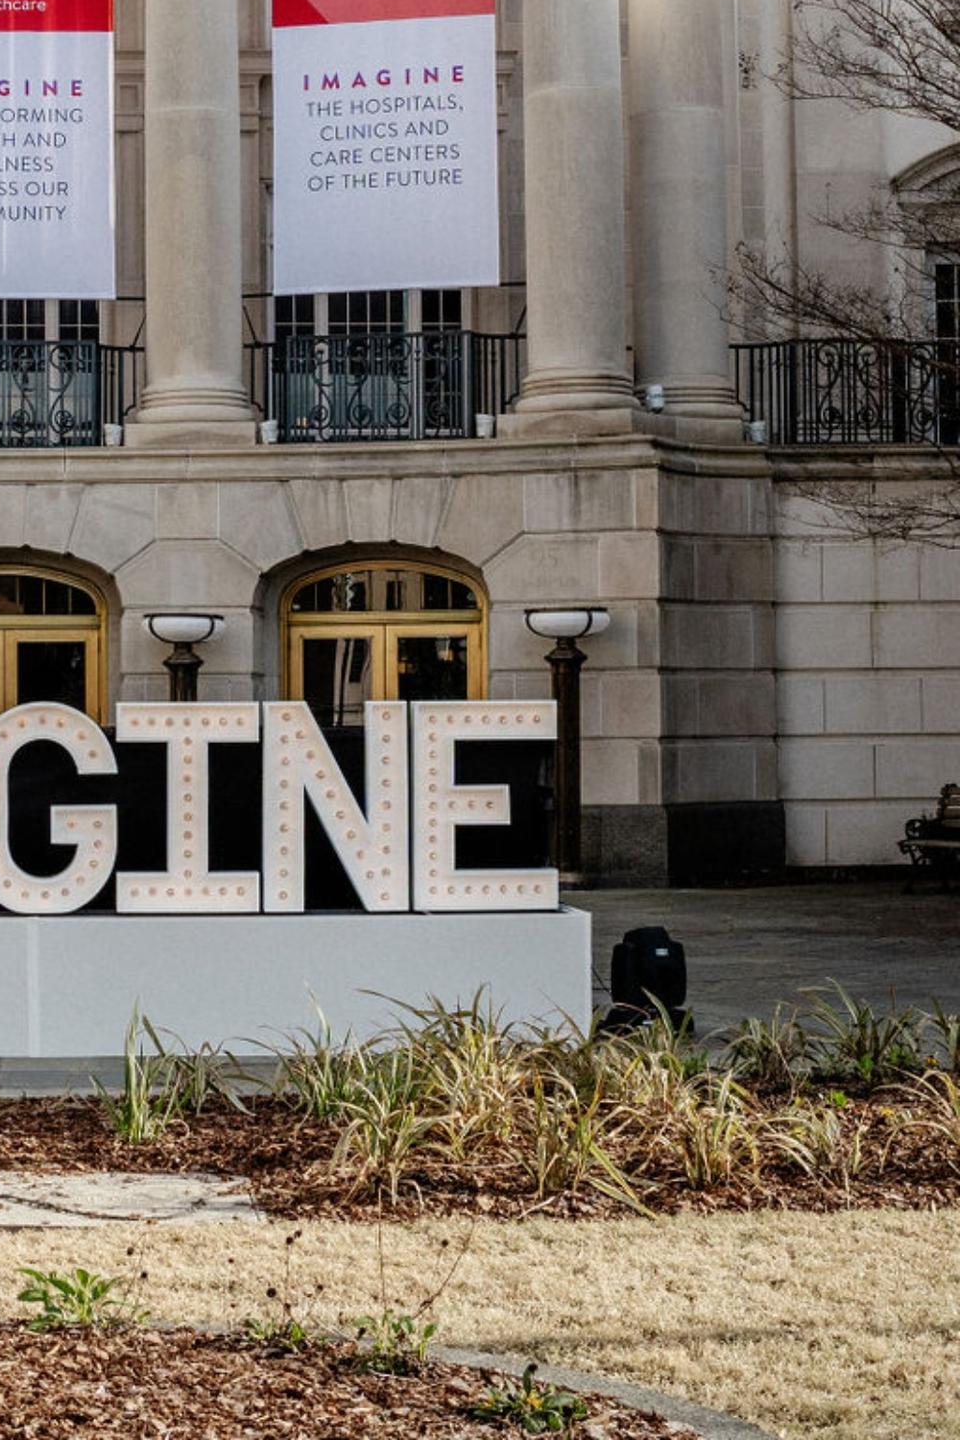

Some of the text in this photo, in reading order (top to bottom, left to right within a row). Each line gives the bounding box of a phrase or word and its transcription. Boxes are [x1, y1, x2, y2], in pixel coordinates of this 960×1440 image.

[304, 65, 464, 91] IMAGINE
[307, 94, 464, 117] THE HOSPITALS,
[23, 132, 67, 148] AND
[320, 120, 449, 141] CLINICS AND
[310, 144, 460, 167] CARE CENTERS
[25, 181, 68, 196] OUR
[307, 169, 462, 192] OF THE FUTURE
